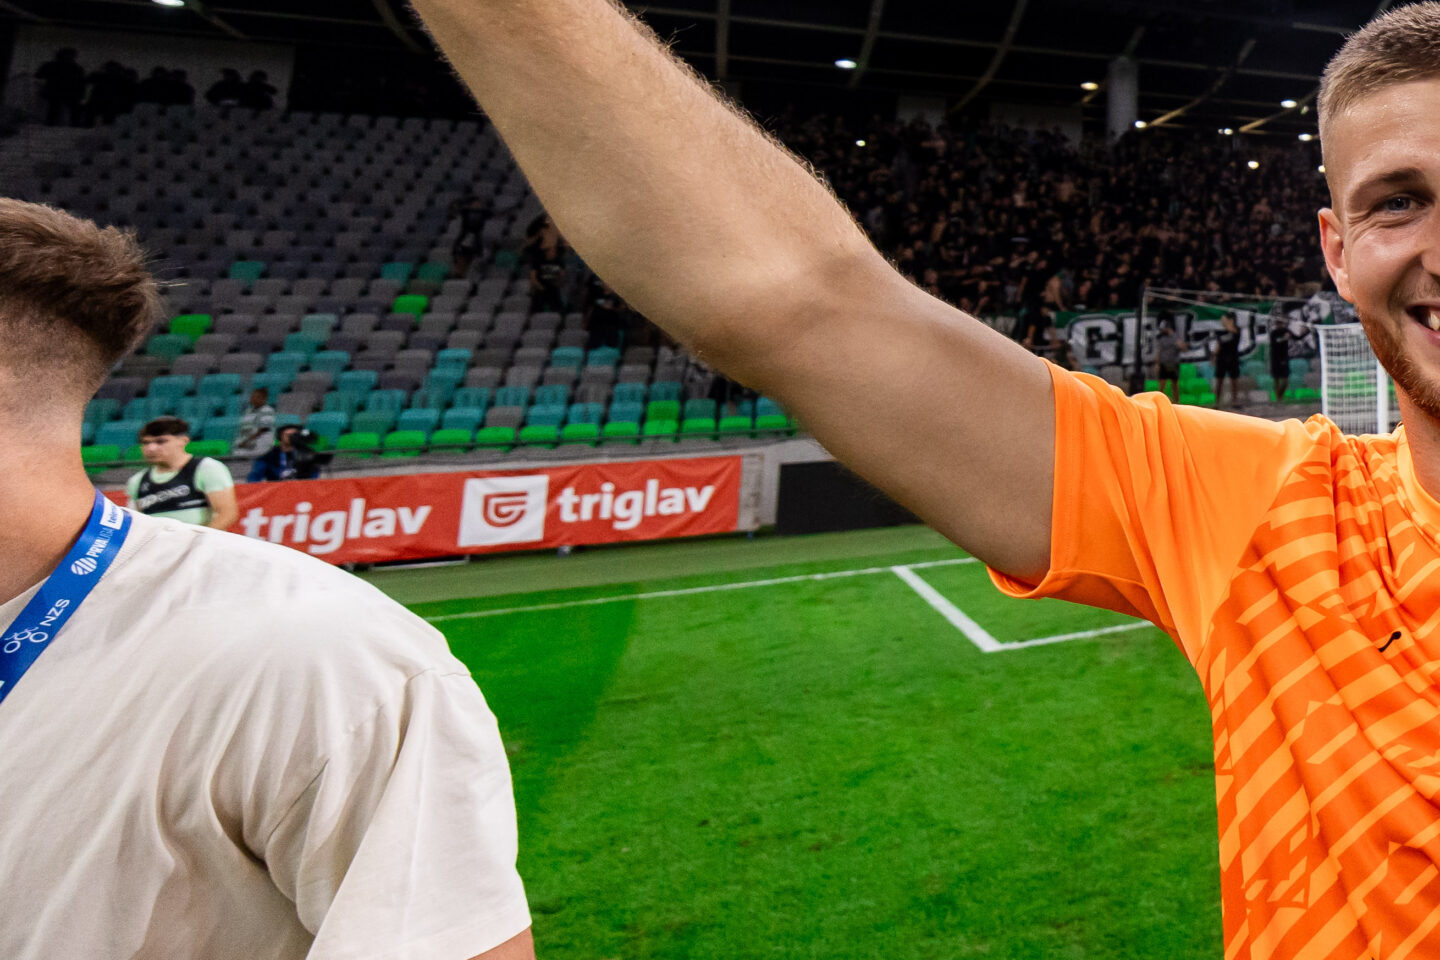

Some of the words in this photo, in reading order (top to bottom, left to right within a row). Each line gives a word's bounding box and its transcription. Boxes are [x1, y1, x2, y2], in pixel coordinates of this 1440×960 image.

[241, 498, 431, 554] triglav
[559, 482, 715, 531] triglav
[39, 599, 70, 627] NZS
